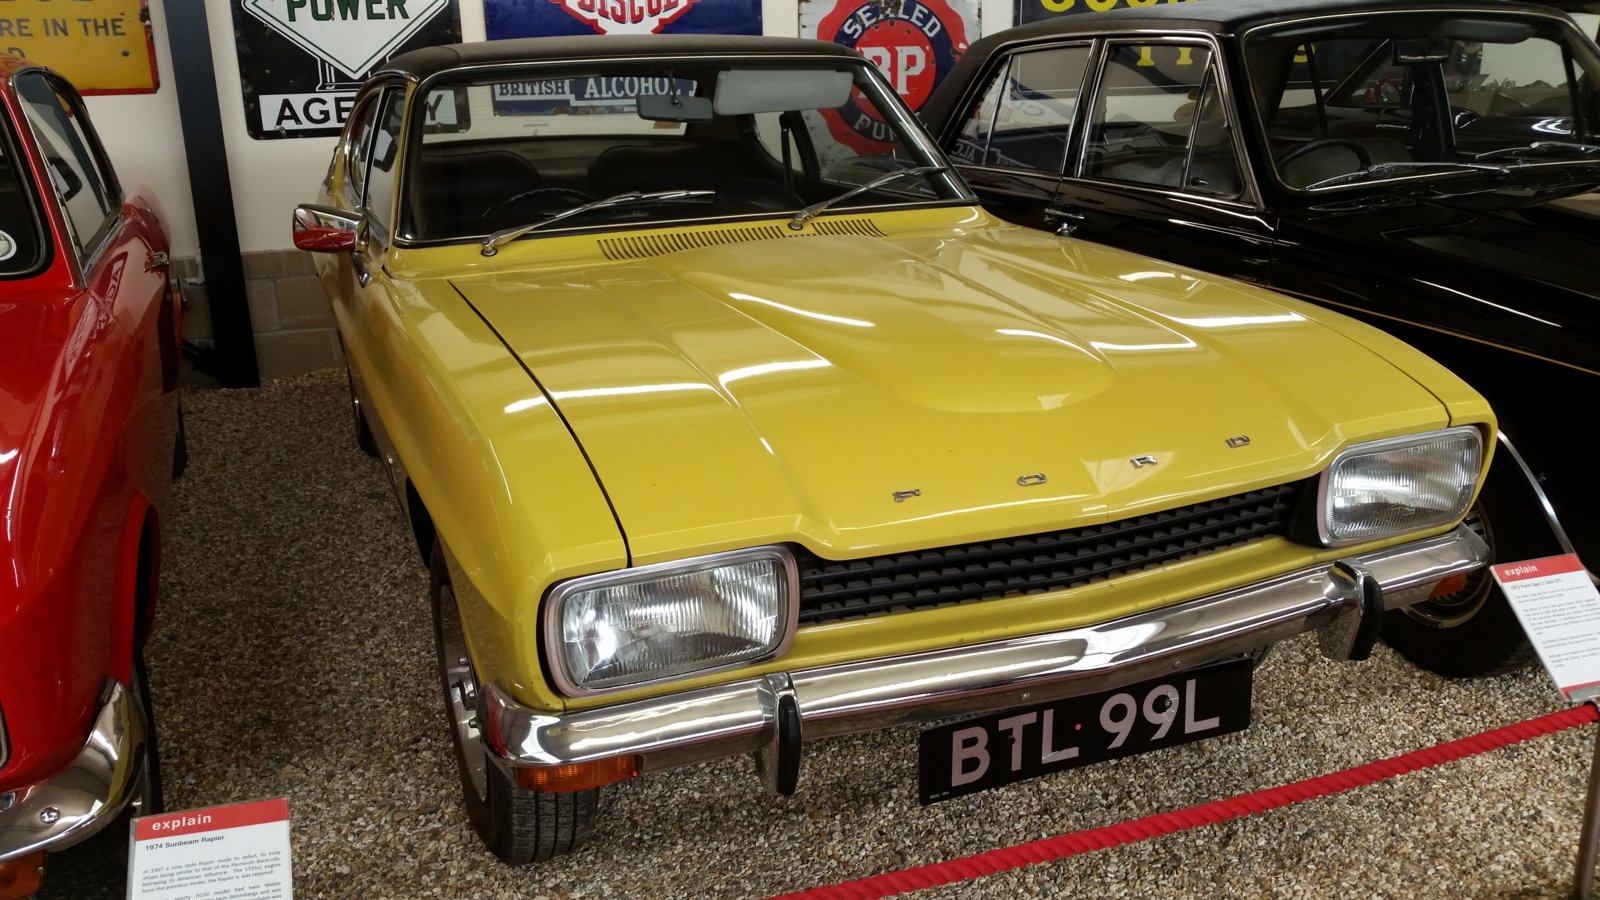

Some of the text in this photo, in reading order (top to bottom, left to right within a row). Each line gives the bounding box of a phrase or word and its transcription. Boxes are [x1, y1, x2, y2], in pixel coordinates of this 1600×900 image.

[42, 18, 69, 37] IN
[77, 18, 126, 37] THE
[843, 0, 941, 39] SEALED
[857, 45, 926, 98] BP
[499, 80, 567, 97] BRITISH
[1504, 565, 1538, 576] explain
[952, 678, 1220, 787] BTL 99L
[152, 814, 212, 831] explain
[145, 835, 224, 851] 1974 Sunbeam Rapier
